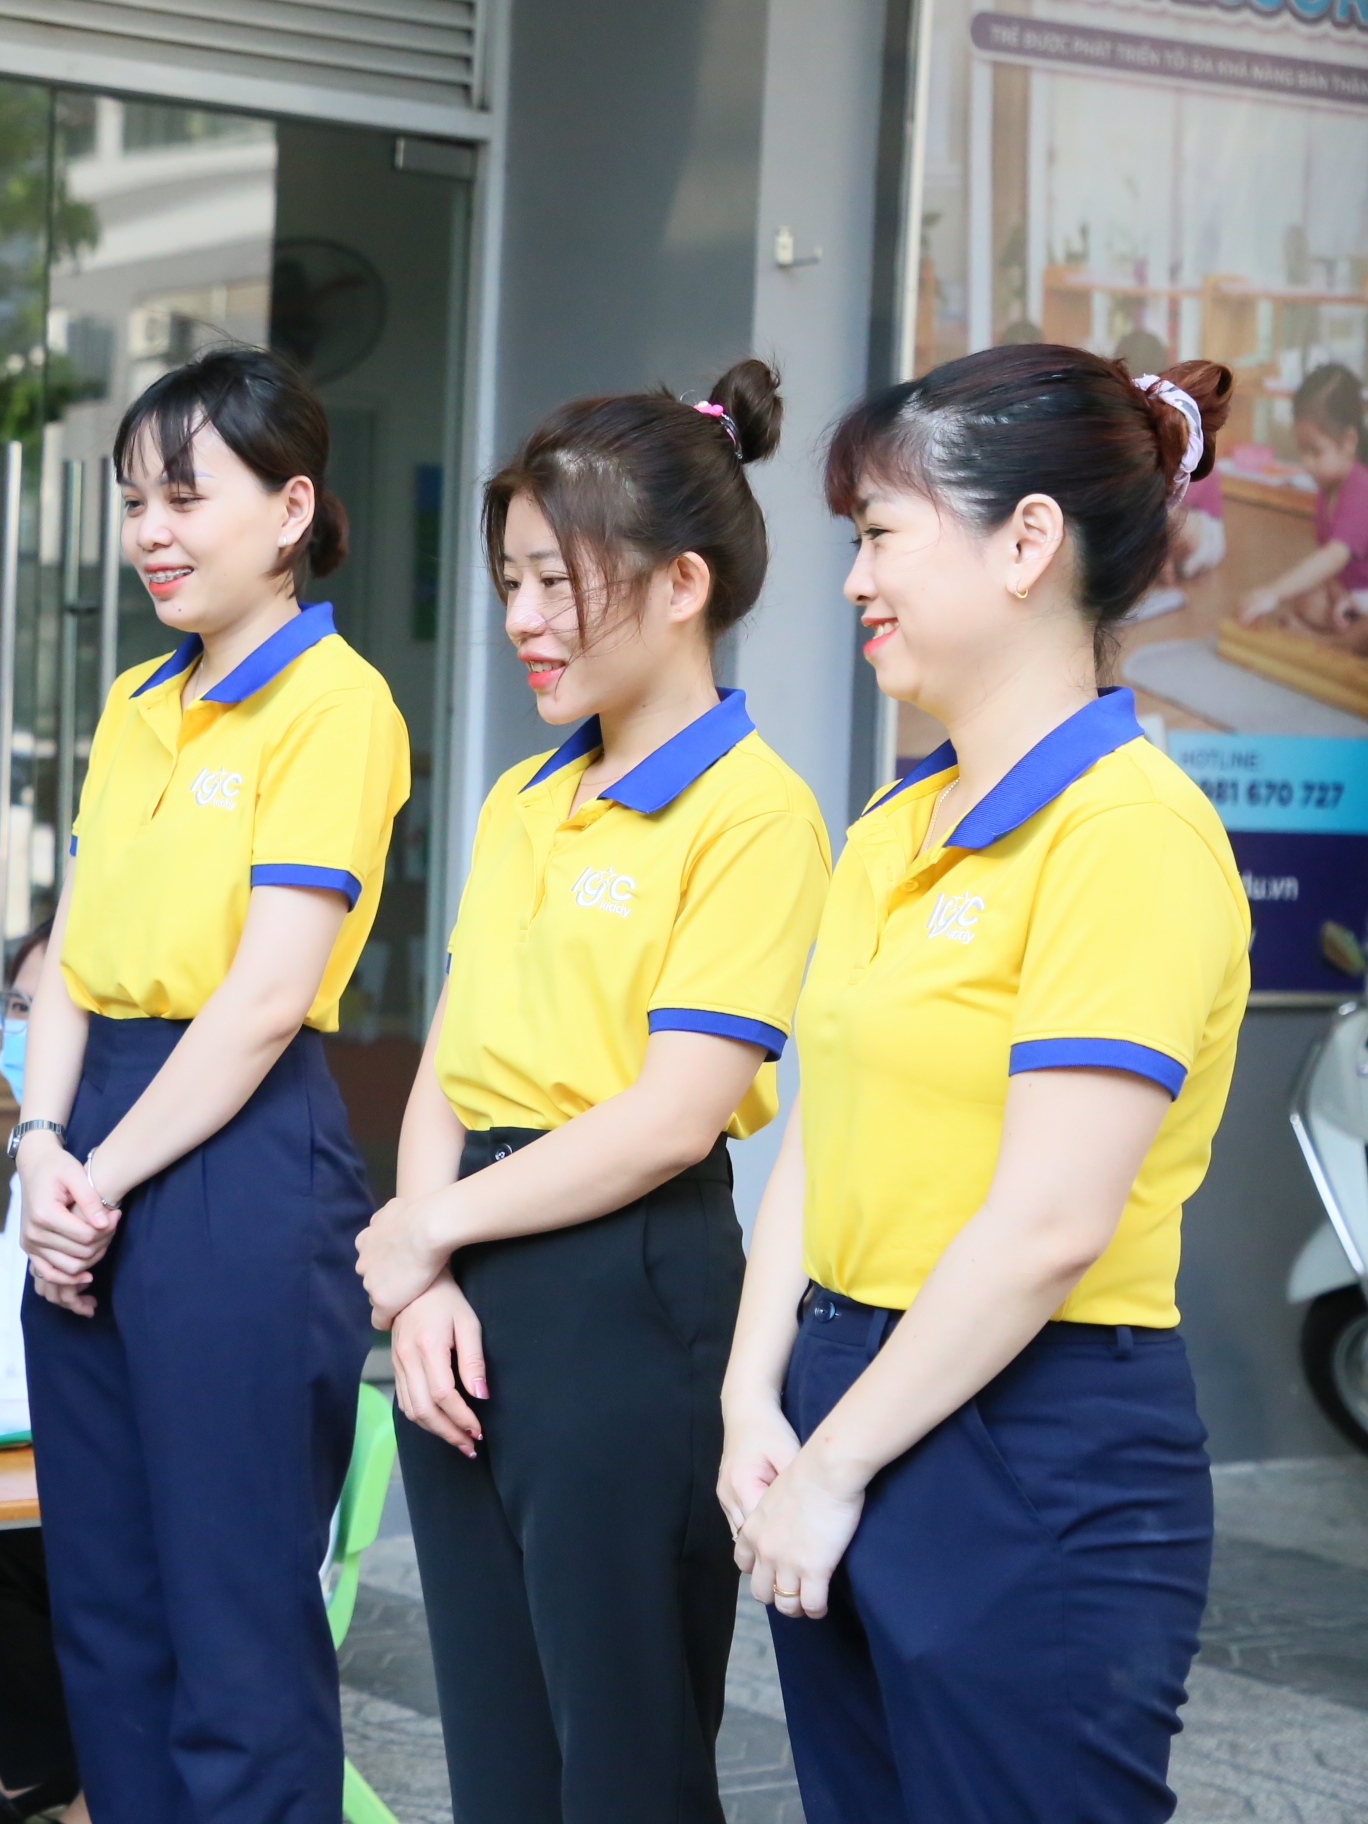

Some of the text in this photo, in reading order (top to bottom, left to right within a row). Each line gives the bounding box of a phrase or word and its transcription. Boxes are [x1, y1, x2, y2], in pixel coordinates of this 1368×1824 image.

[1179, 750, 1258, 771] HOTLINE
[1198, 777, 1345, 809] 981 670 727
[599, 900, 632, 919] kiddy
